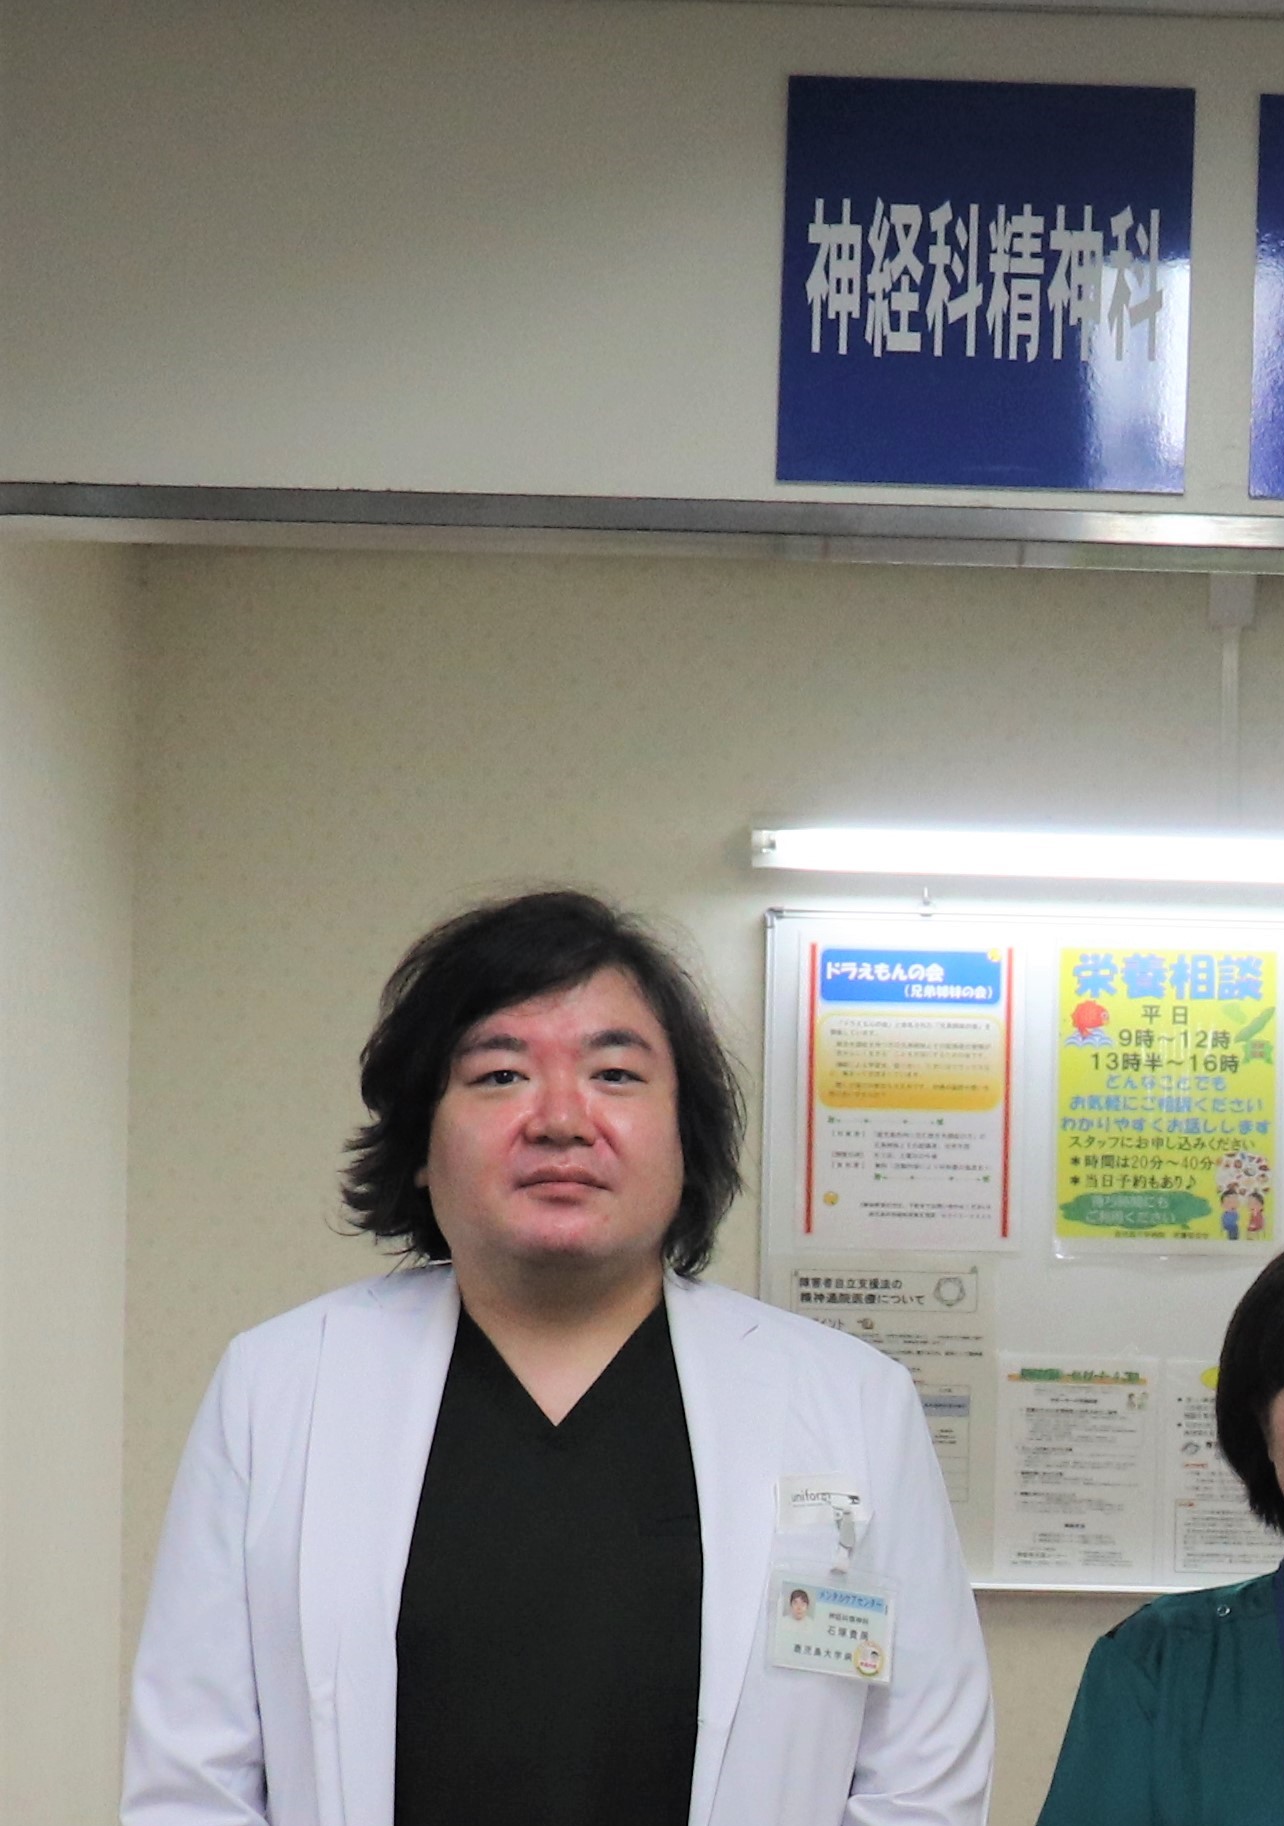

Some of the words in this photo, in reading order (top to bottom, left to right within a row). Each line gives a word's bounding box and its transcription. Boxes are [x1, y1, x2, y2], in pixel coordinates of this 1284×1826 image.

[805, 197, 1164, 363] 神経科精神科
[826, 961, 945, 982] ドラえもんの会
[1073, 953, 1263, 1000] 栄養相談
[1106, 1075, 1228, 1091] どんなことでも
[1068, 1135, 1257, 1152] スタッフにお申し込みください
